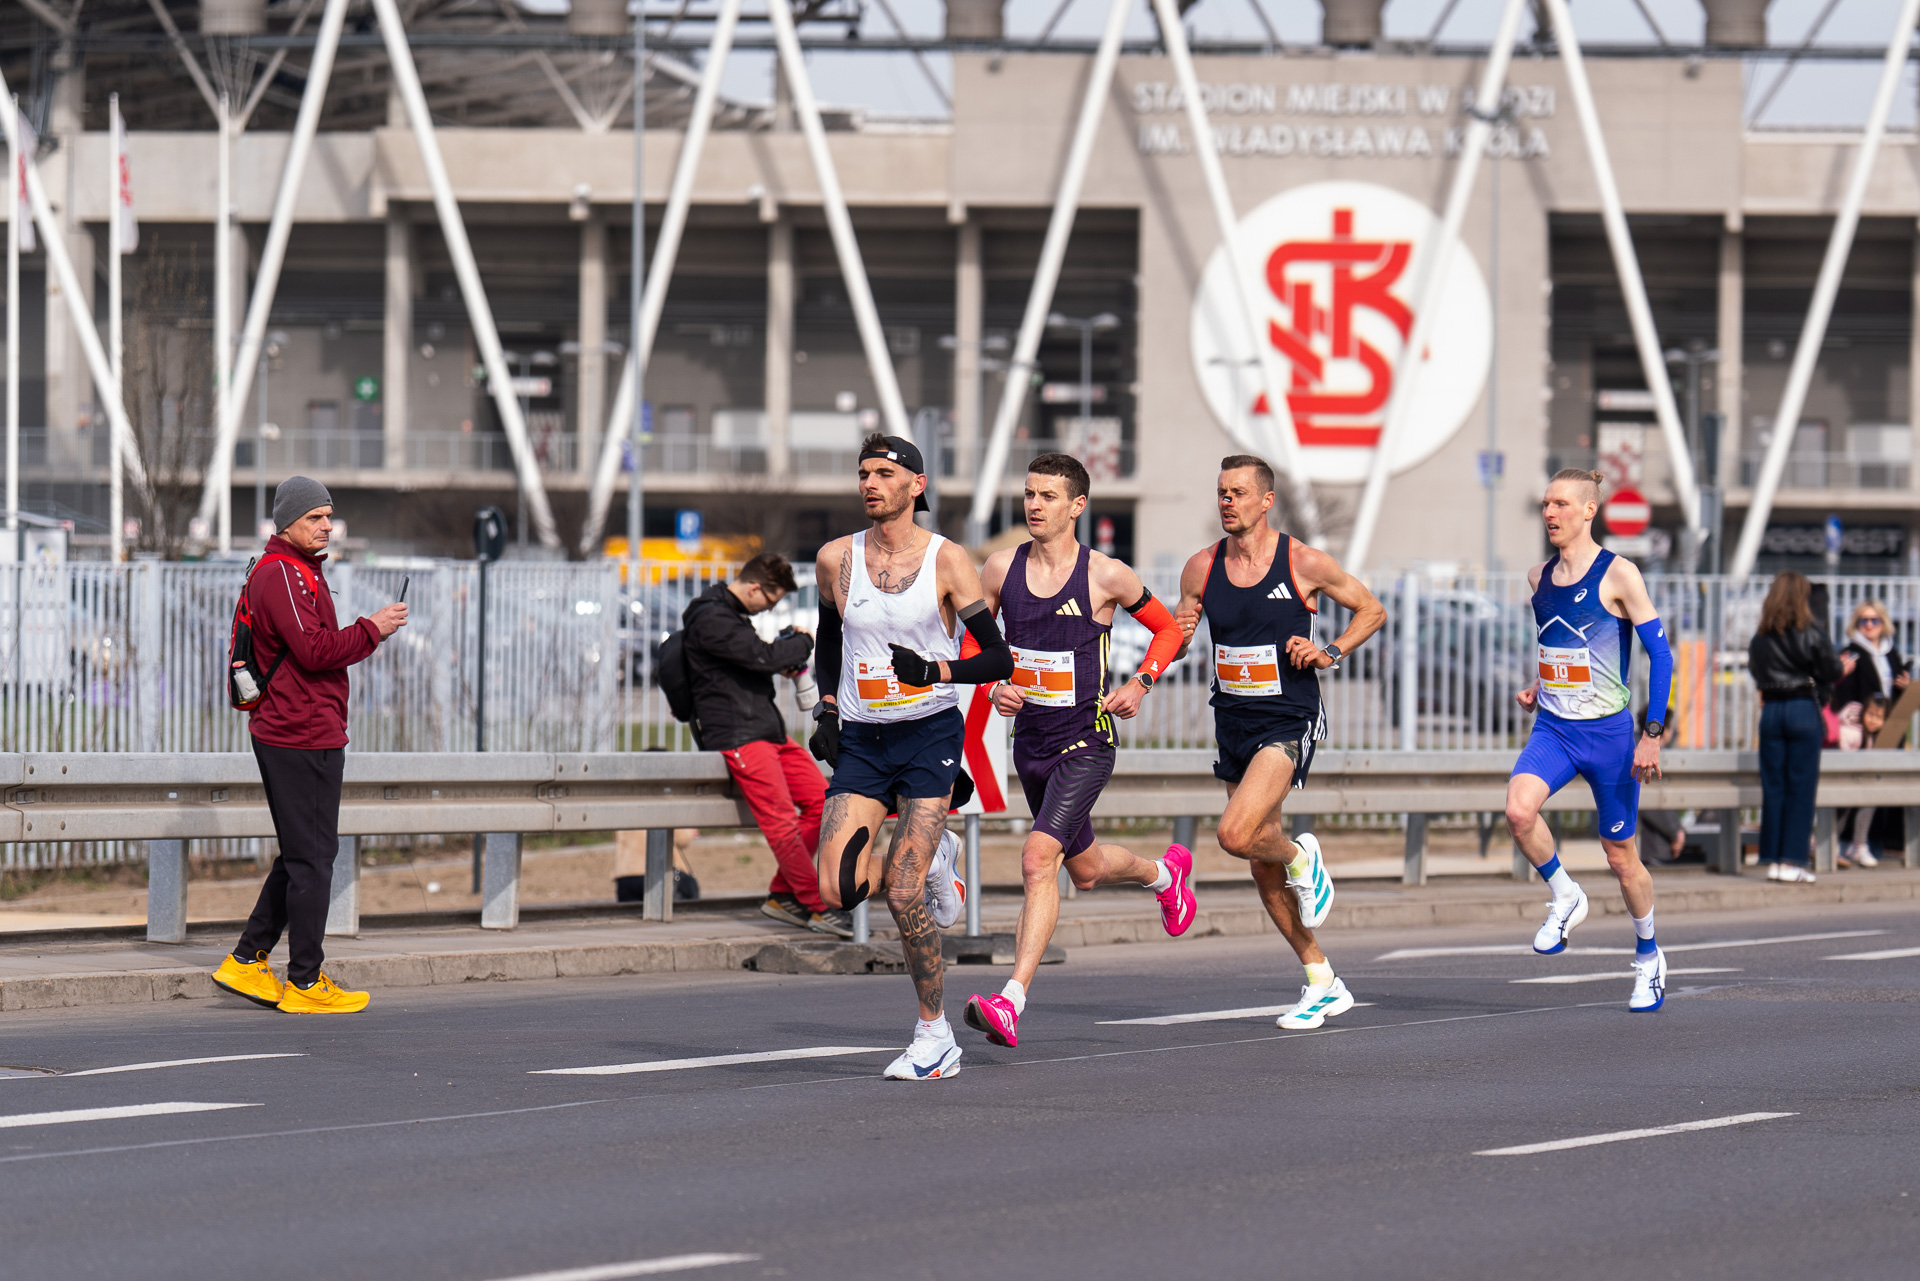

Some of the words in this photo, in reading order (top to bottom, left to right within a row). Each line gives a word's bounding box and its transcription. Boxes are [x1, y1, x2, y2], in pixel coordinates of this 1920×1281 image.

[1286, 82, 1406, 114] MIEJSKI
[1416, 84, 1450, 115] W
[1443, 119, 1550, 157] KÓLA
[1034, 670, 1041, 686] 1
[1240, 665, 1250, 678] 4
[1551, 665, 1569, 678] 10
[886, 679, 900, 694] 5
